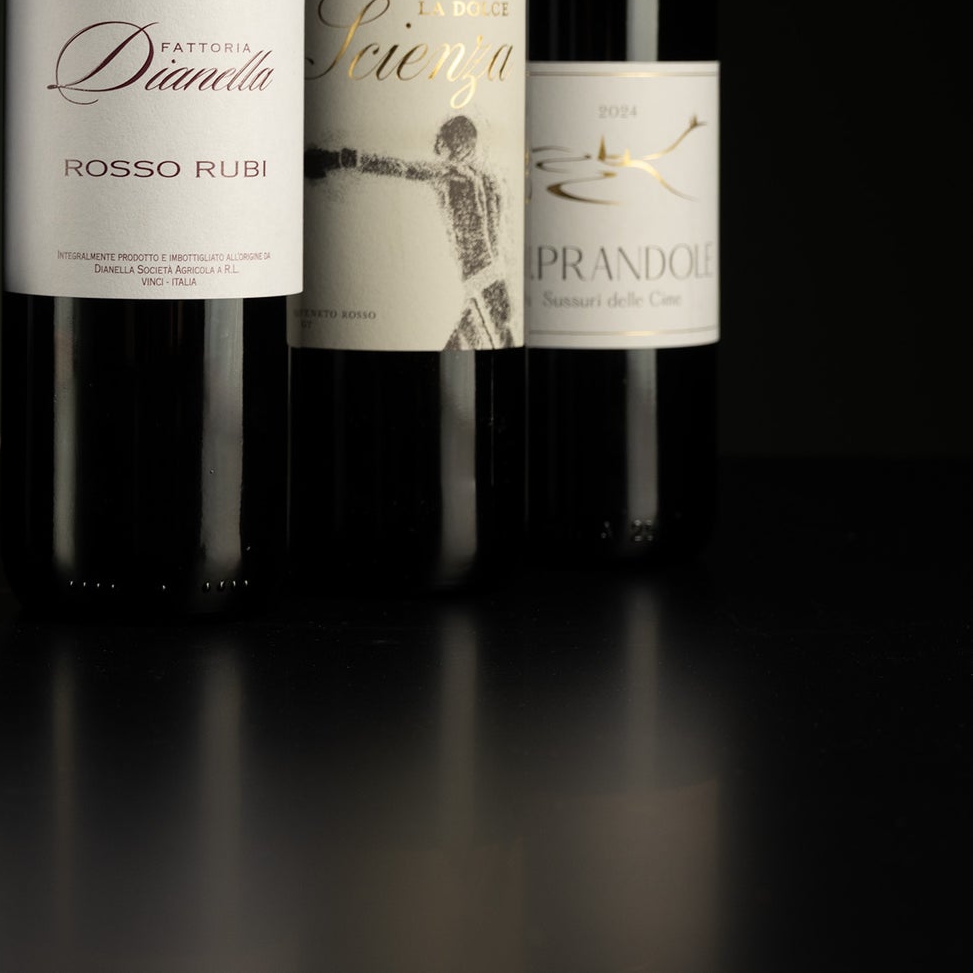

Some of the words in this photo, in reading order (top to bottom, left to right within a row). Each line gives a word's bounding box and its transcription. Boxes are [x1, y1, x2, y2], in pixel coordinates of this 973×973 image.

[418, 0, 445, 16] LA
[452, 0, 509, 17] DOLCE
[161, 42, 252, 53] FATTORIA
[46, 21, 275, 105] Dianella
[598, 104, 637, 119] 2024
[64, 159, 181, 178] ROSSO
[195, 160, 267, 178] RUBI
[118, 253, 159, 262] PRODOTTO
[161, 254, 167, 262] E
[169, 254, 224, 262] IMBOTTIGLIATO
[529, 241, 716, 281] PRANDOLE
[141, 277, 163, 286] VINCI
[171, 277, 196, 286] ITALIA
[542, 290, 601, 308] Sussuri
[607, 291, 643, 308] delle
[341, 310, 376, 320] ROSSO
